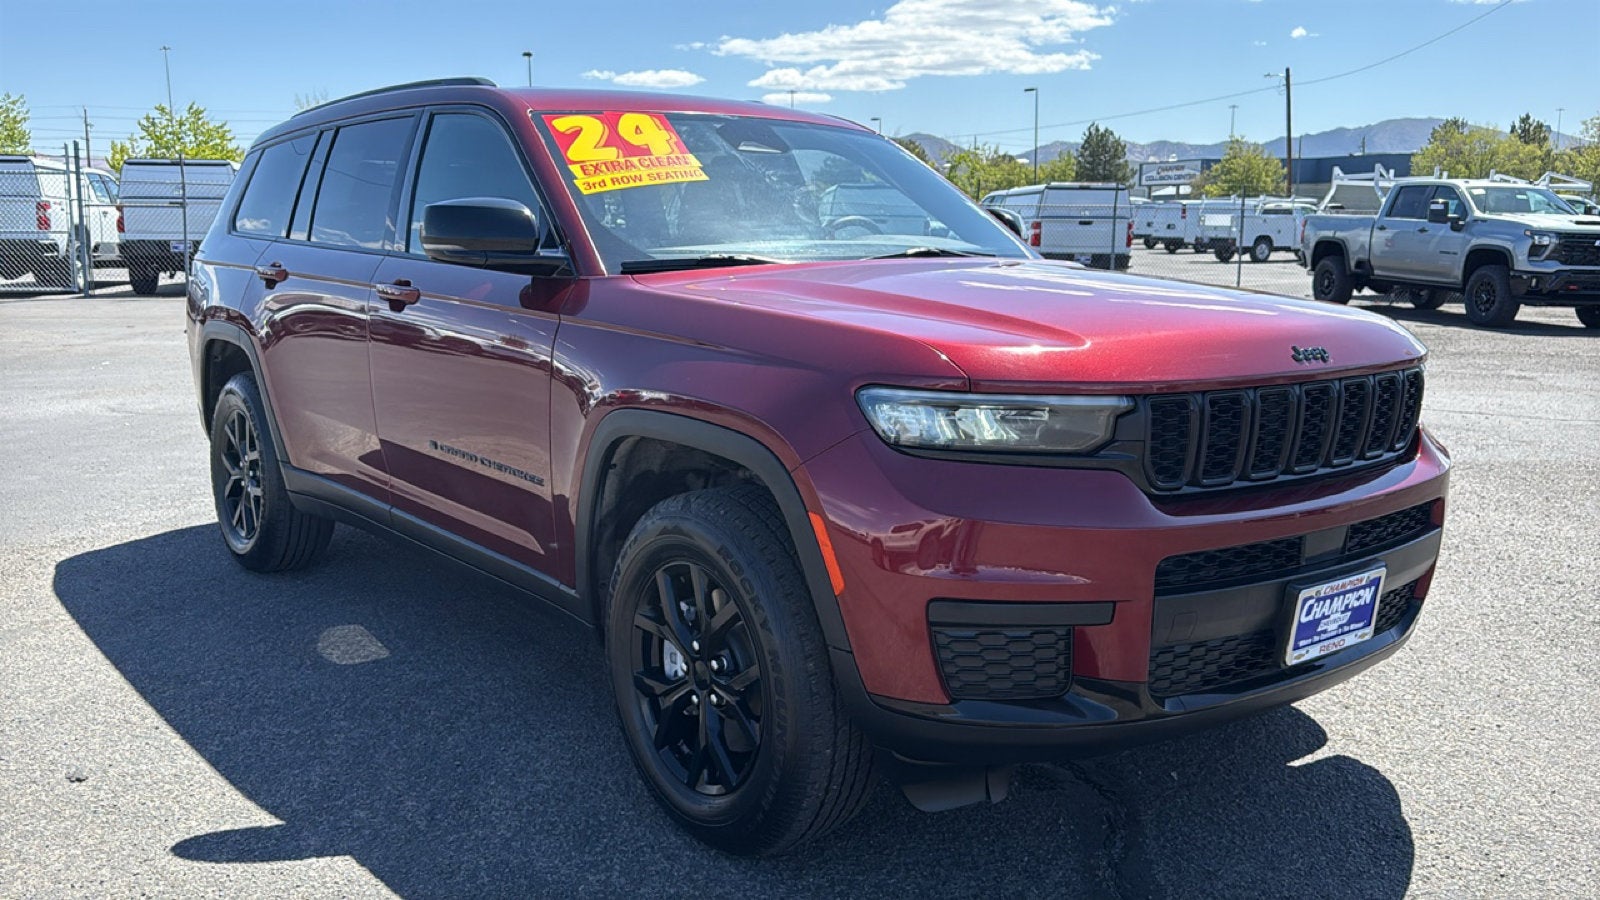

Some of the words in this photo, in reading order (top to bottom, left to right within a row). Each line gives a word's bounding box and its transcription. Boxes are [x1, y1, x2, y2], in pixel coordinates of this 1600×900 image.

[551, 112, 676, 162] 24
[580, 156, 637, 176] EXTRA
[638, 155, 690, 169] CLEAN
[582, 179, 607, 192] 3rd
[612, 174, 643, 187] ROW
[647, 169, 703, 181] SEATING
[1291, 345, 1330, 364] Jeep
[440, 444, 479, 463] GRAND
[480, 457, 545, 486] CHEROKEE
[1323, 576, 1366, 595] CHAMPION
[1300, 586, 1375, 623] CHAMPION
[1319, 639, 1346, 653] RENO
